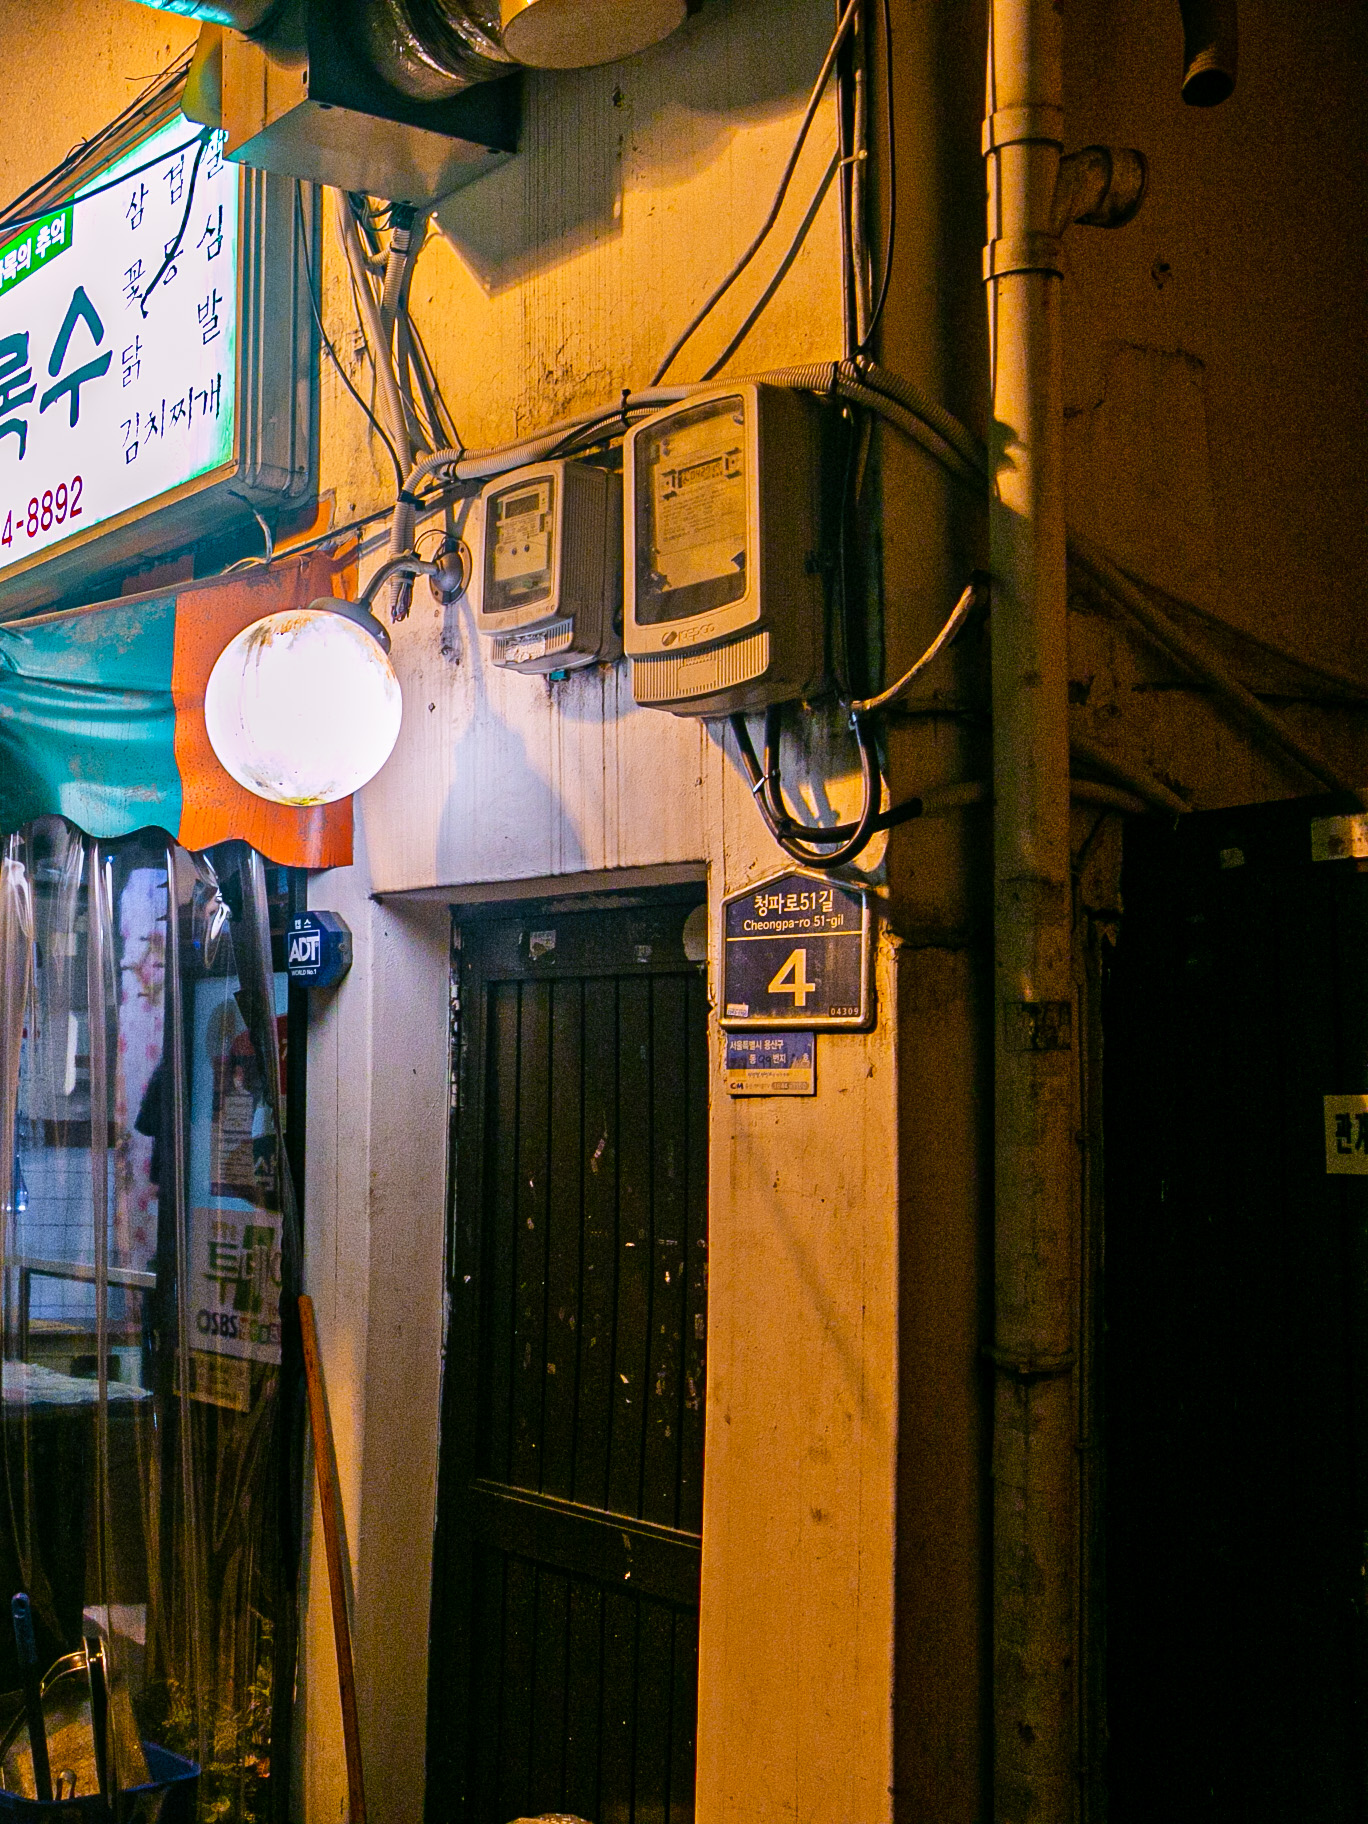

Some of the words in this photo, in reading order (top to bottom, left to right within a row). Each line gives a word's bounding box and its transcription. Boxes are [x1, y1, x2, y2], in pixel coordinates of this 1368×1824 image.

[35, 212, 66, 259] 추억
[120, 372, 222, 465] 김치찌개
[754, 889, 833, 917] 청파로51길
[743, 918, 810, 932] Cheongpa-ro
[814, 914, 844, 928] 51-gil
[288, 935, 320, 963] ADT
[767, 948, 816, 1007] 4
[830, 1006, 859, 1016] 04309
[730, 1040, 762, 1051] 서울특별시
[764, 1039, 784, 1051] 용산구
